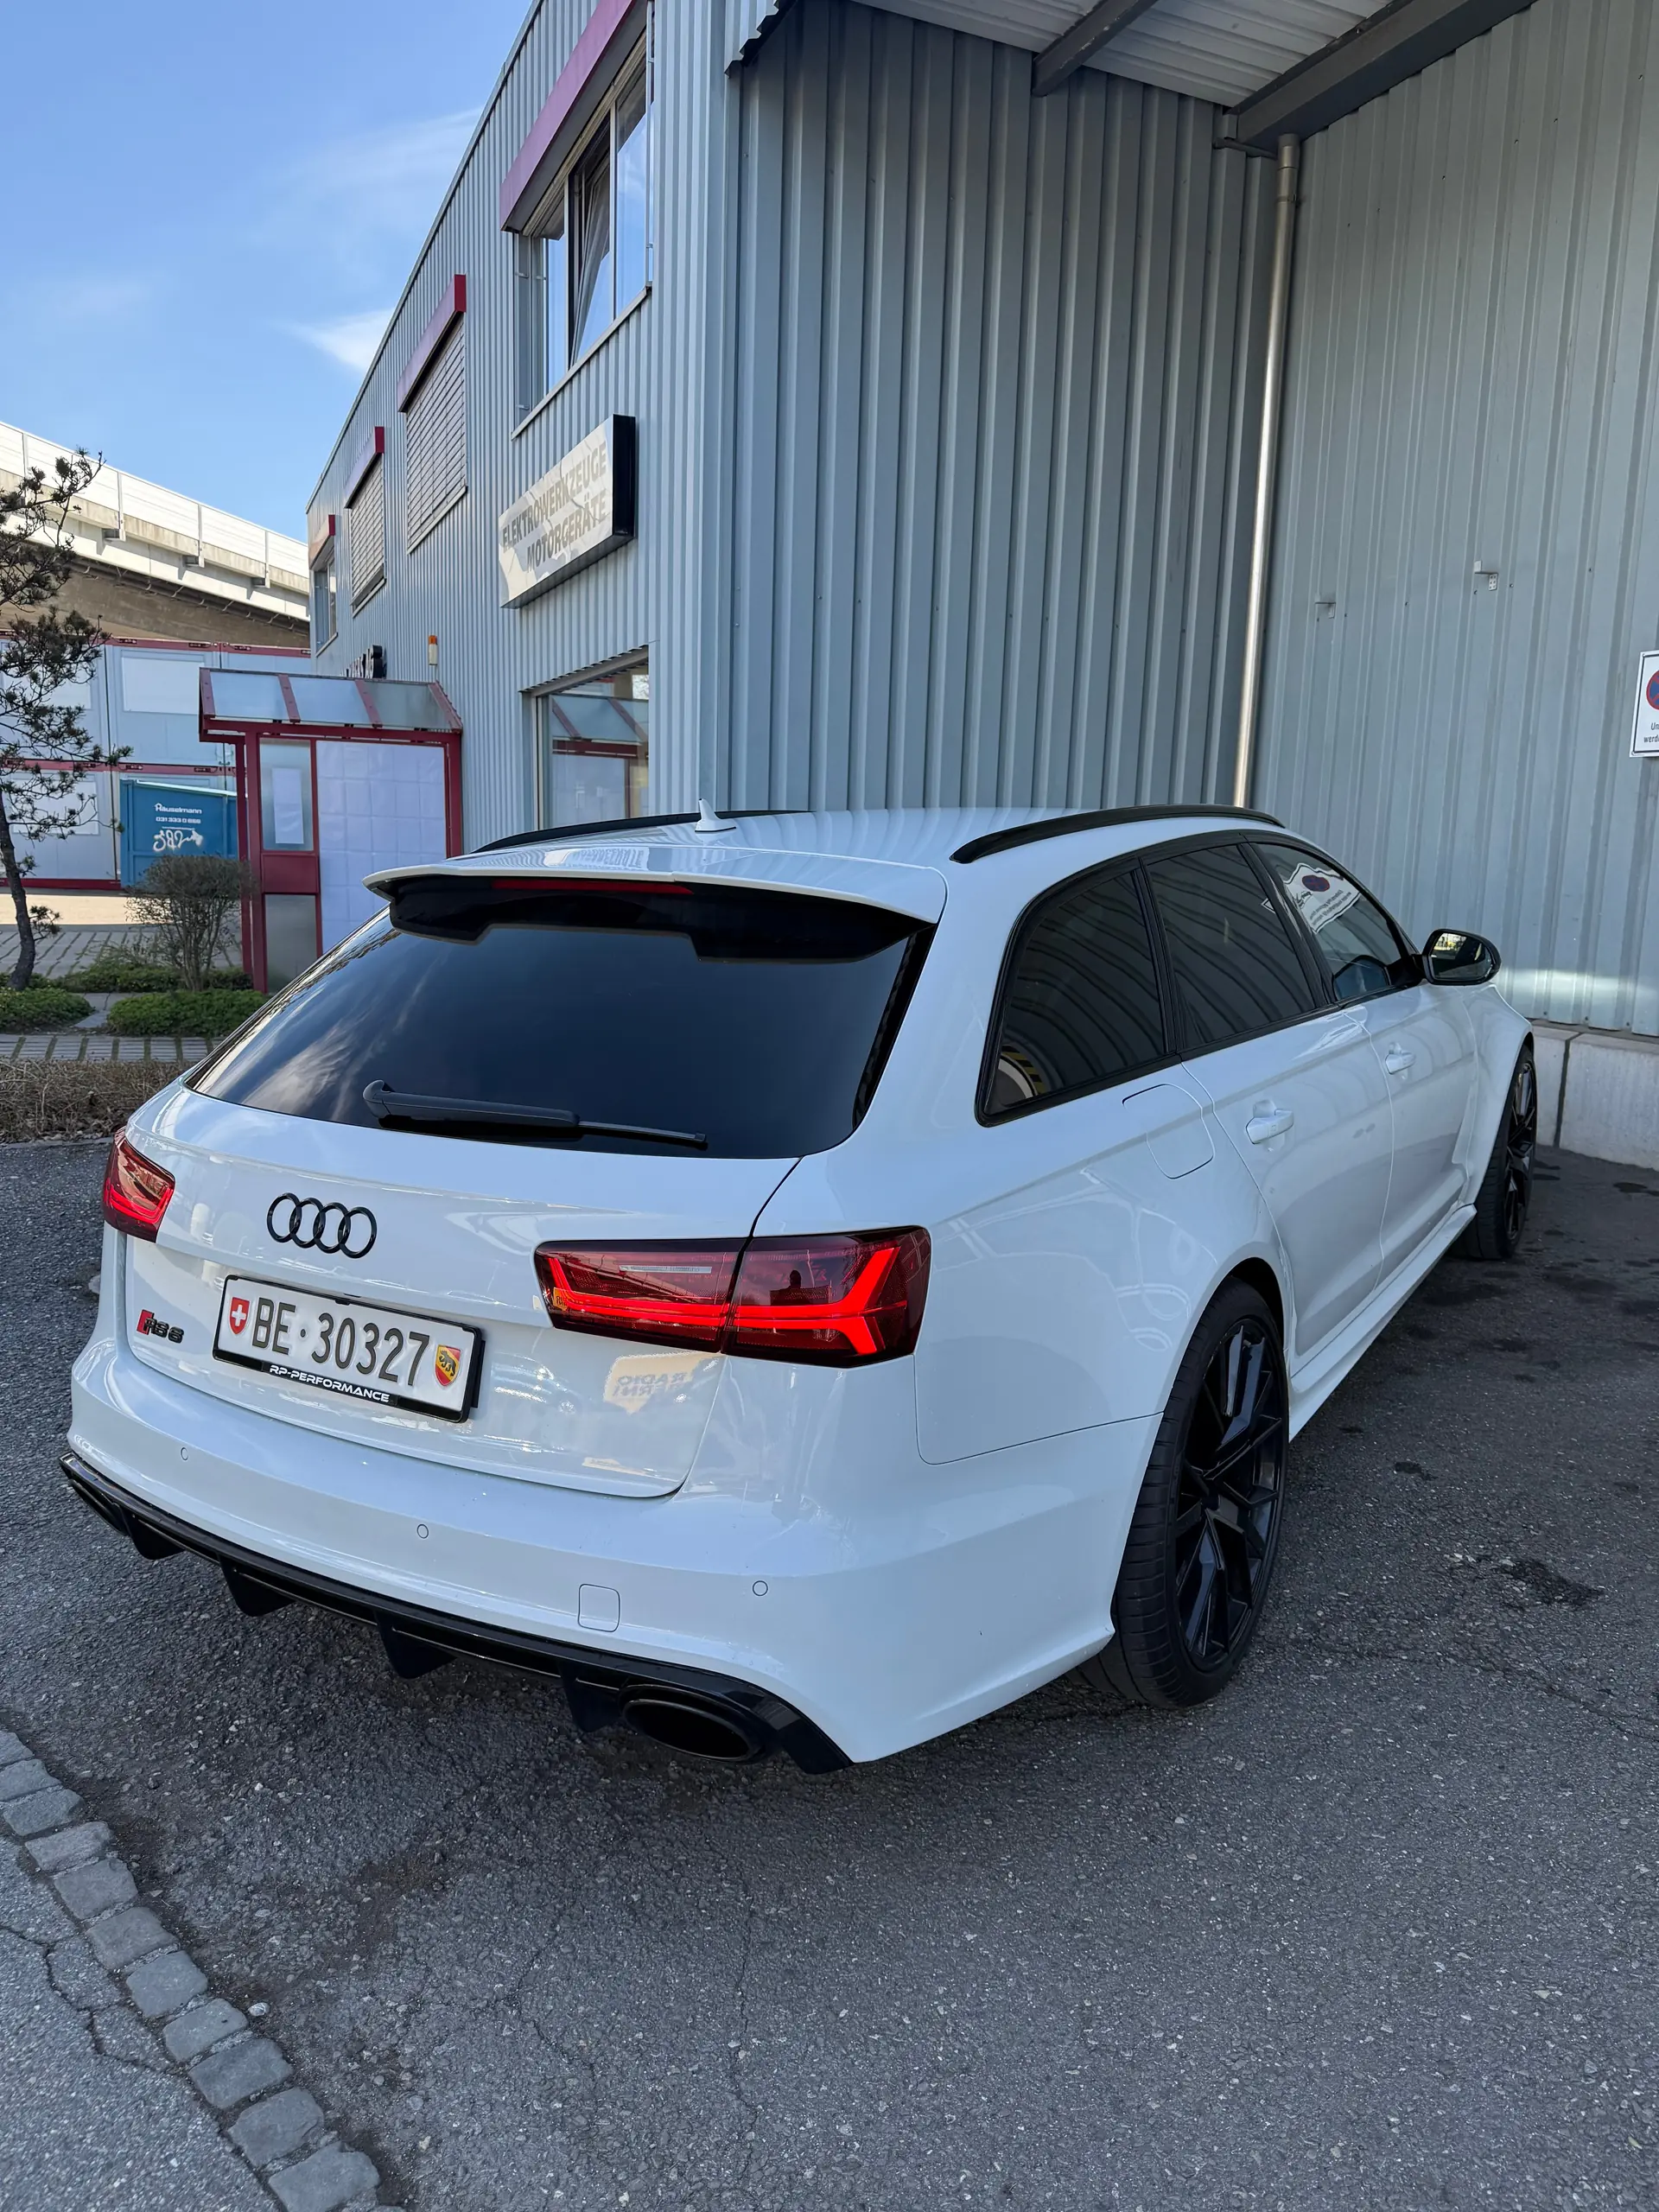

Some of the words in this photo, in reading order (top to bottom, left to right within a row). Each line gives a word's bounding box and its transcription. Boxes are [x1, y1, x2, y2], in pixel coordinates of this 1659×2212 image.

[503, 442, 607, 552] ELEKTROWERKZEUGE
[527, 488, 607, 573] MOTORGERÄTE
[270, 1364, 390, 1402] RP-PERFORMANCE
[311, 1313, 430, 1387] 30327
